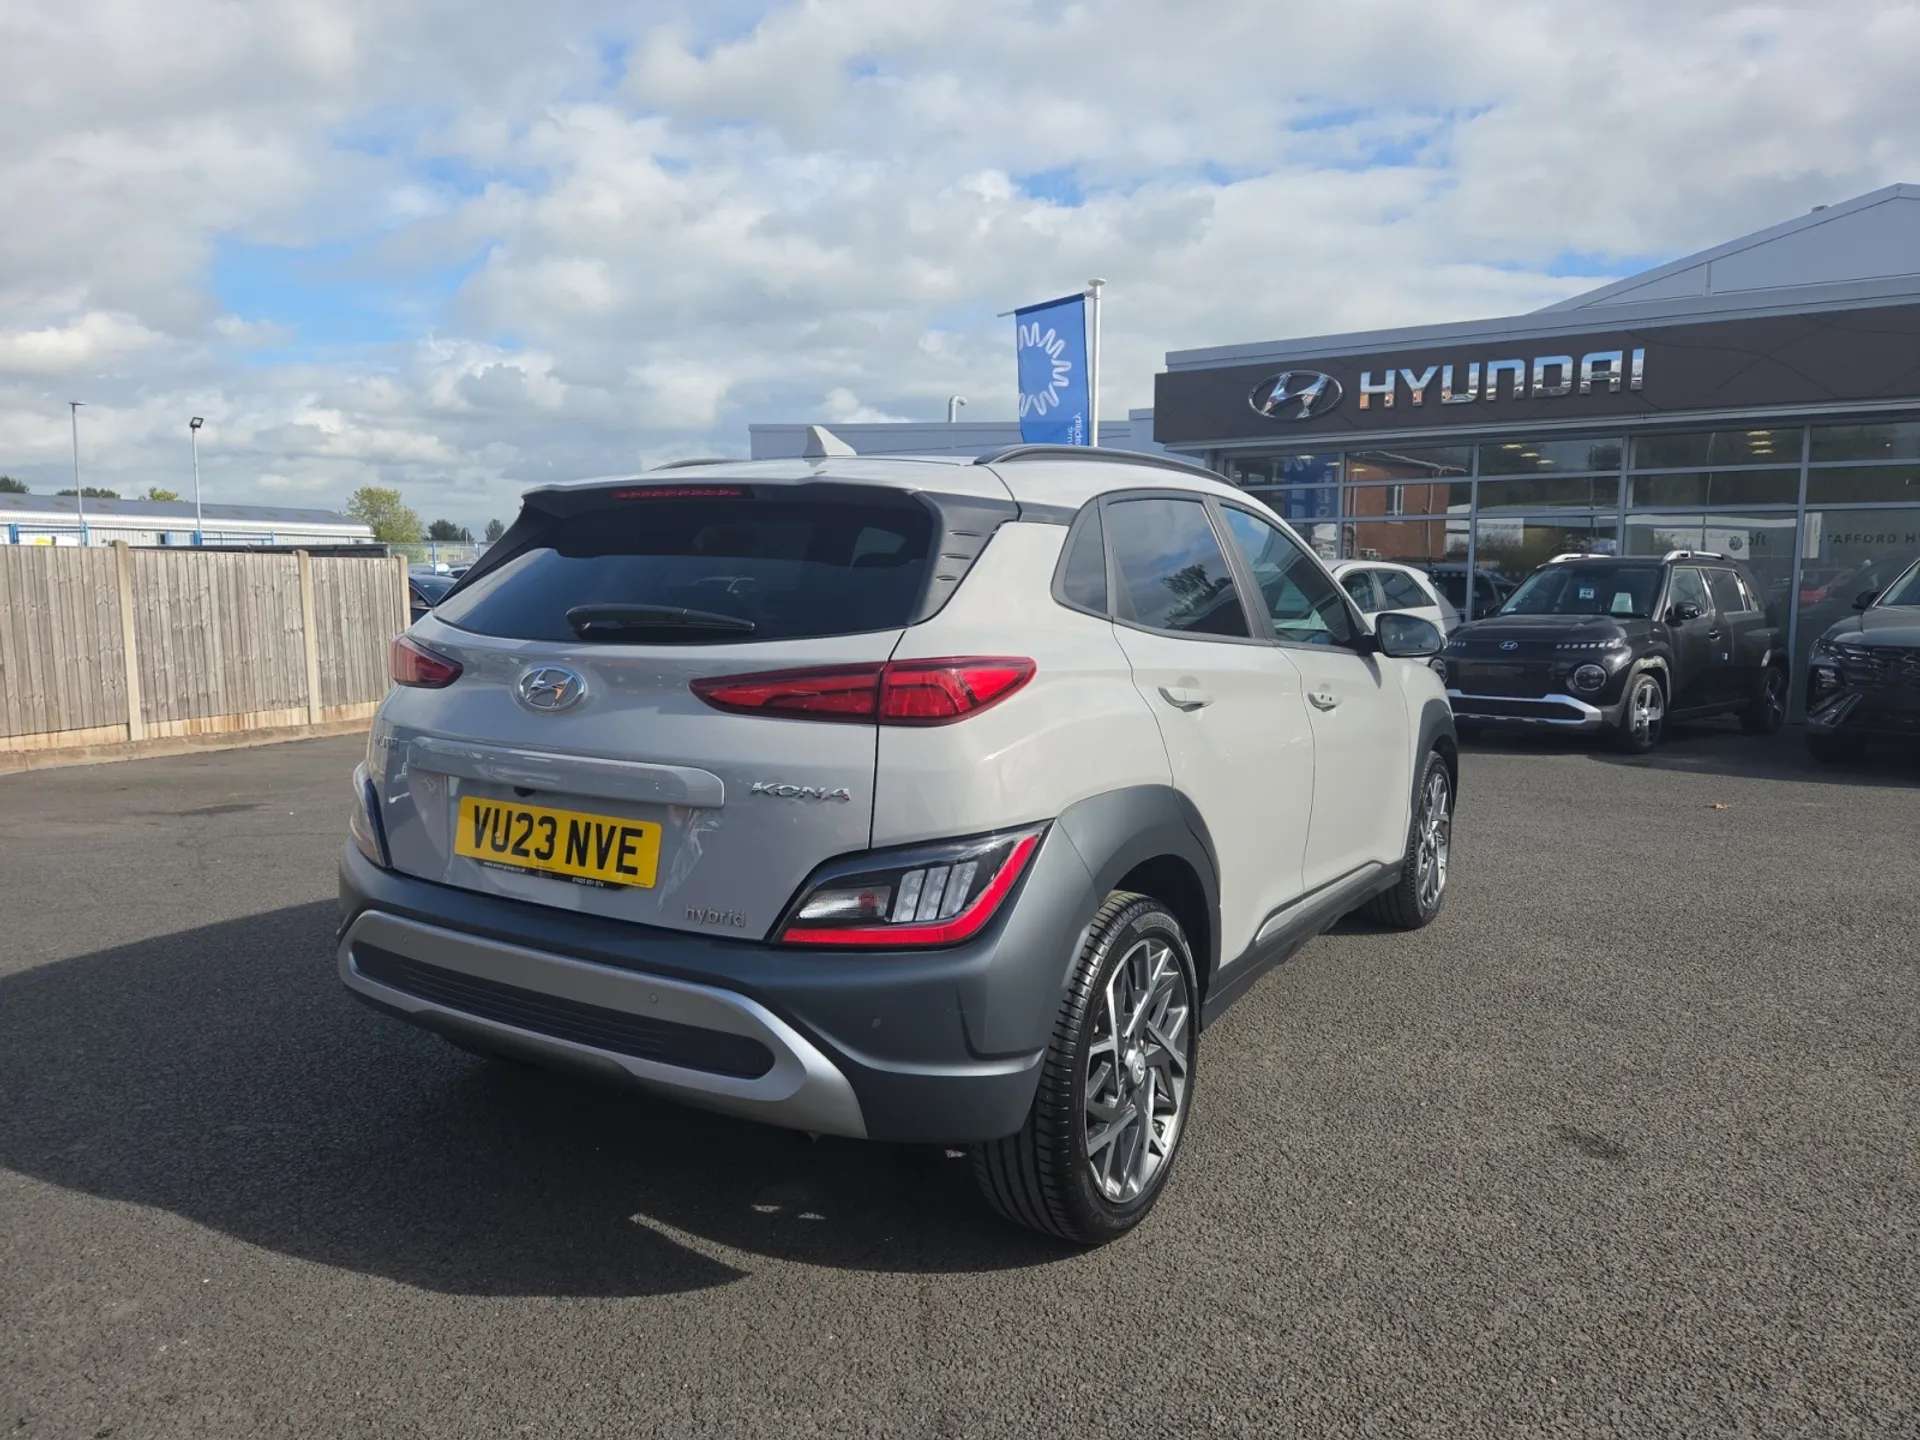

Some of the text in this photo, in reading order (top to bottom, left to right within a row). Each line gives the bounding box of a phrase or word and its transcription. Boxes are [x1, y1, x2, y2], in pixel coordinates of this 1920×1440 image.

[1359, 348, 1645, 409] HYUNDAI
[751, 781, 851, 802] KONA
[473, 804, 644, 876] VU23 NVE
[685, 904, 746, 928] hybrid
